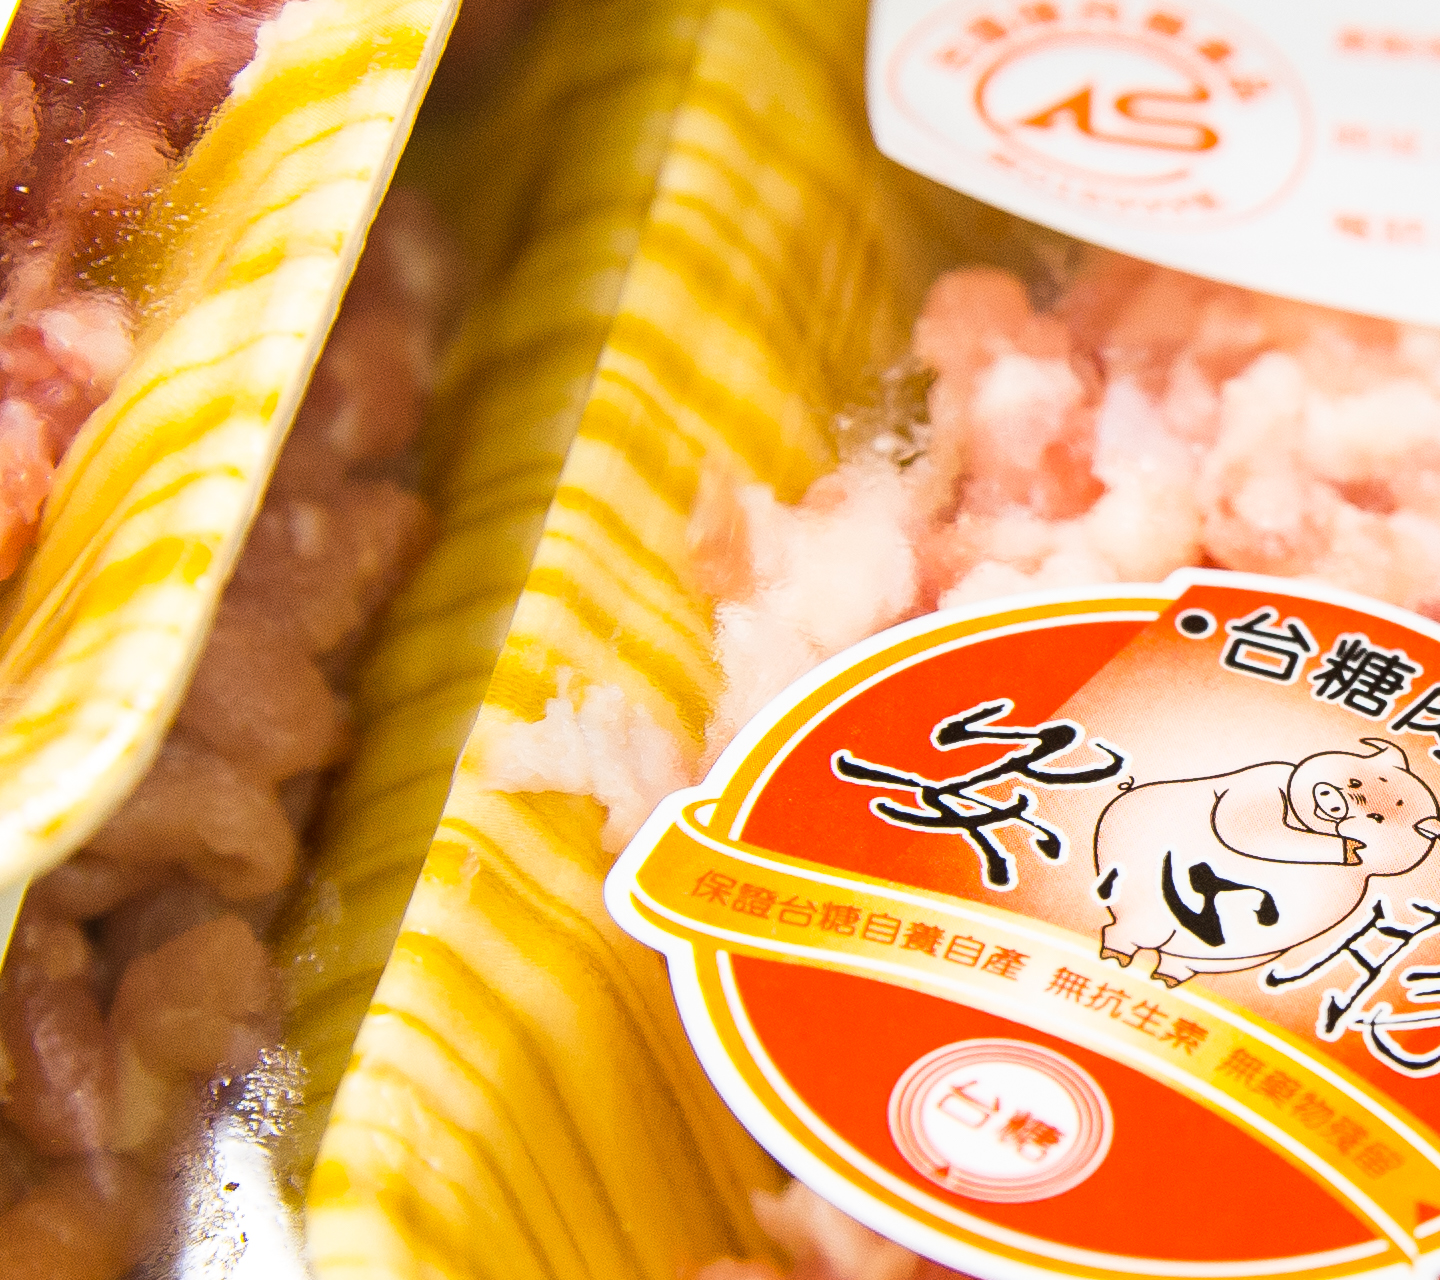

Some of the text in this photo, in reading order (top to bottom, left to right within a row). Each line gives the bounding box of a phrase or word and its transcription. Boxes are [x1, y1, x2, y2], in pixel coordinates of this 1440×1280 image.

[688, 868, 1033, 984] 保證台糖自養自產
[1042, 963, 1212, 1059] 無抗生素
[936, 1078, 1070, 1166] 台糖
